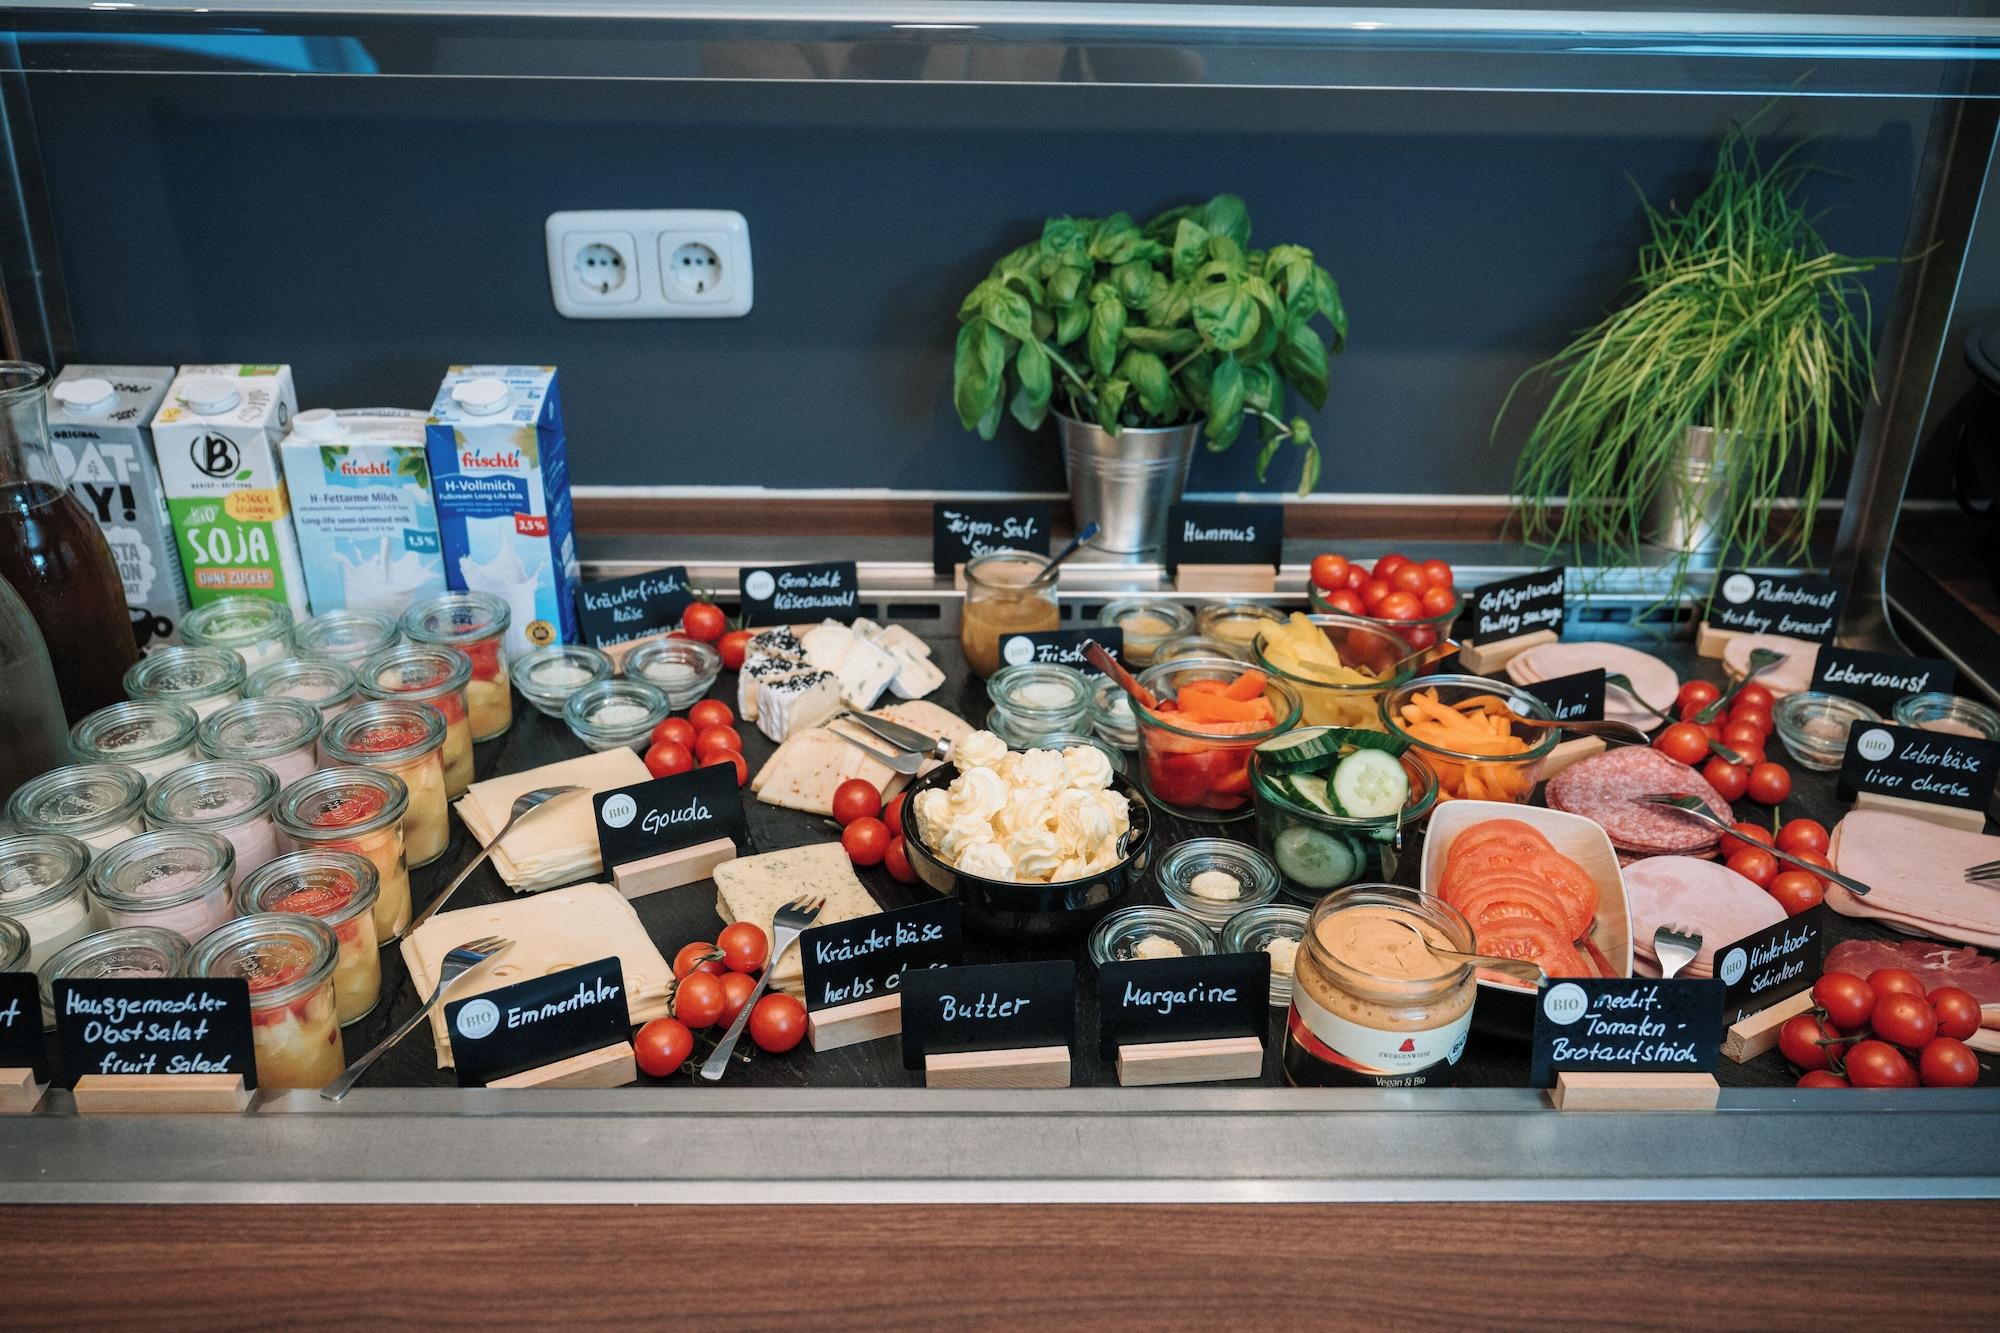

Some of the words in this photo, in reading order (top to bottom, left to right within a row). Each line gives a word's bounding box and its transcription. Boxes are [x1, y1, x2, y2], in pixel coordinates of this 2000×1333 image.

[53, 431, 101, 440] ORIGINAL
[341, 459, 392, 476] frischli
[461, 449, 521, 469] frischli
[445, 480, 516, 492] H-Vollmilch
[371, 491, 399, 503] Milch
[1183, 519, 1256, 543] Hummus
[199, 571, 227, 585] OHNE
[1822, 661, 1931, 694] Leberwurst
[1864, 739, 1888, 752] BIO
[1900, 742, 1982, 773] Leberkäse
[1864, 768, 1904, 787] liver
[608, 804, 630, 820] BIO
[641, 796, 713, 836] Gouda
[1725, 958, 1743, 977] BIO
[823, 976, 875, 1004] herbs
[1122, 981, 1238, 1015] Margarine
[507, 976, 620, 1030] Emmentaler
[938, 992, 1031, 1022] Butter
[1552, 997, 1580, 1012] BIO
[465, 1010, 492, 1029] BIO
[1377, 1049, 1432, 1060] ZWERGENWIESE
[1552, 1037, 1698, 1066] Brotaufstrich
[99, 1050, 157, 1075] fruit
[1375, 1076, 1404, 1088] Vegan
[1404, 1077, 1413, 1087] &
[1413, 1075, 1427, 1087] Bio
